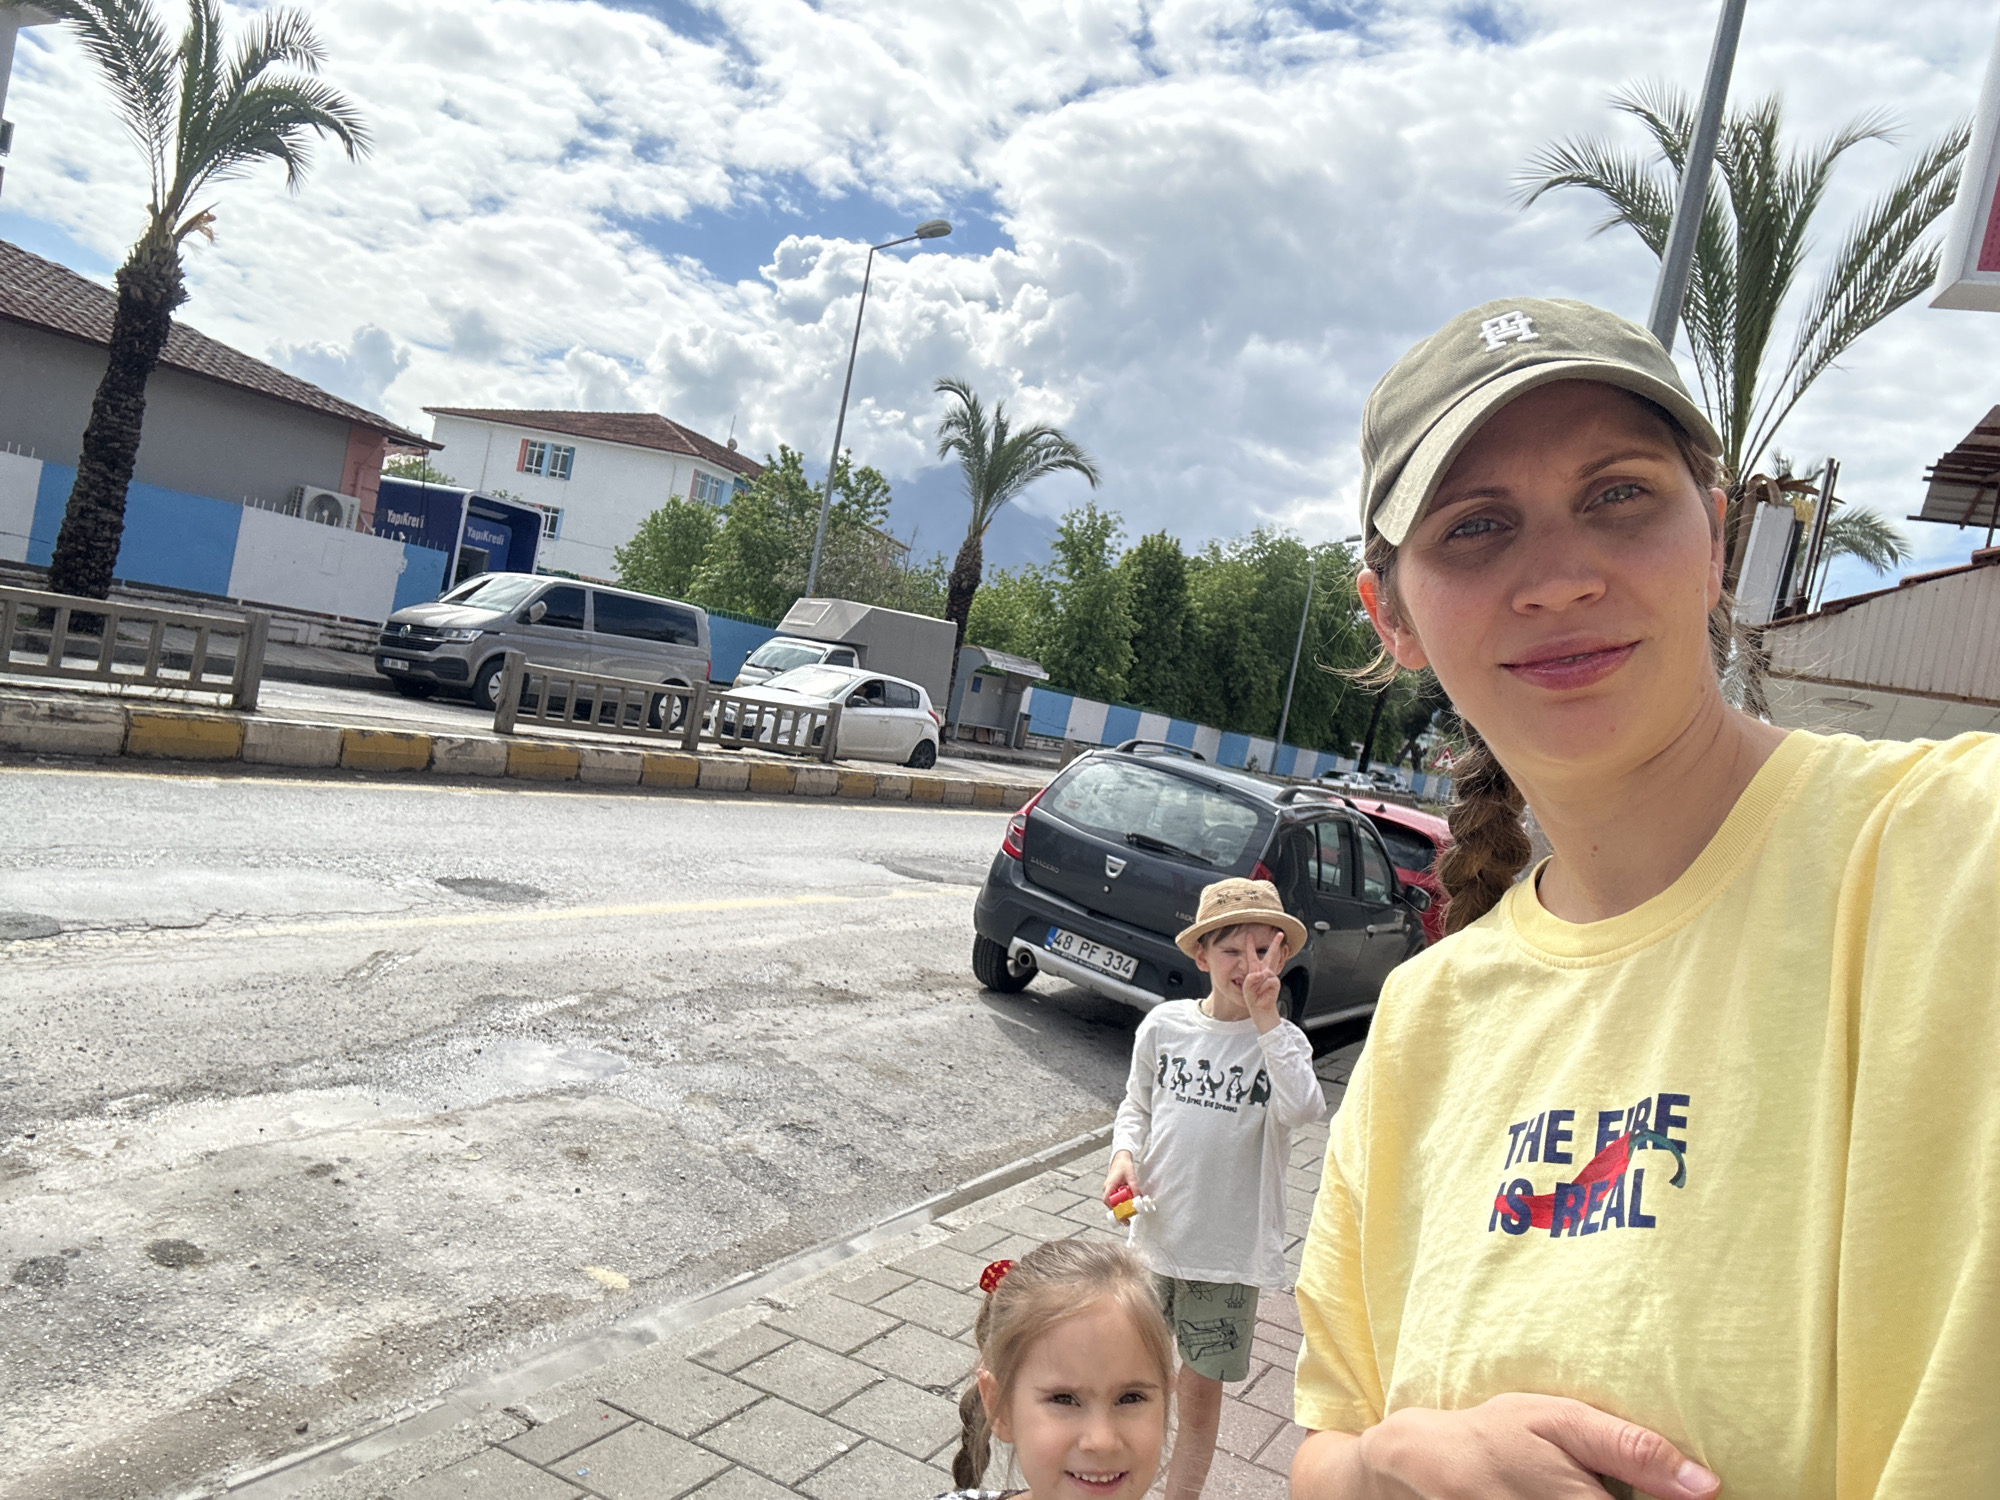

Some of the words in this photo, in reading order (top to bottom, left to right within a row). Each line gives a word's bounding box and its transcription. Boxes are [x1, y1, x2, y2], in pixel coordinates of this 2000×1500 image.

[1053, 932, 1074, 951] 48
[1077, 941, 1100, 960] PF
[1102, 951, 1133, 975] 334
[1504, 1109, 1575, 1170] THE
[1595, 1093, 1690, 1157] FIRE
[1488, 1178, 1534, 1236] IS
[1550, 1168, 1656, 1238] REAL
